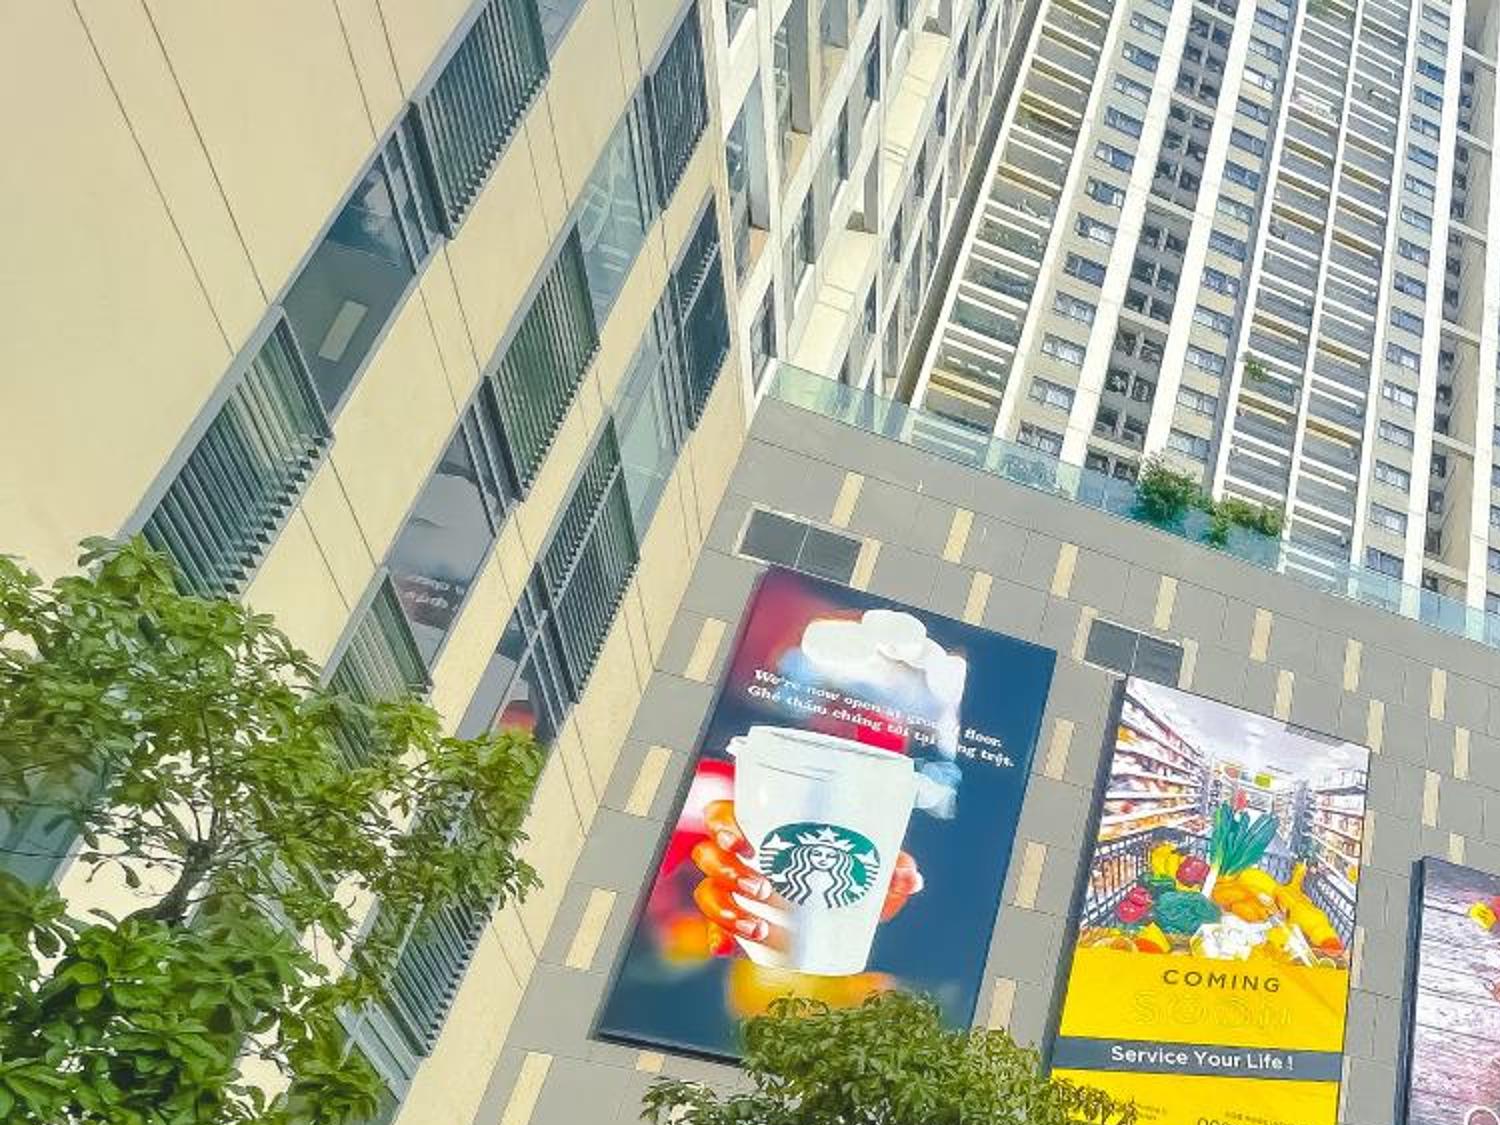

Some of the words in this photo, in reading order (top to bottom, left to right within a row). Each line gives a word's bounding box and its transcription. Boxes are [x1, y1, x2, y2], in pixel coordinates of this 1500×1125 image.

[807, 687, 841, 701] now
[843, 696, 881, 713] open
[1163, 969, 1281, 993] COMING
[1111, 1045, 1189, 1065] Service
[1194, 1050, 1241, 1069] Your
